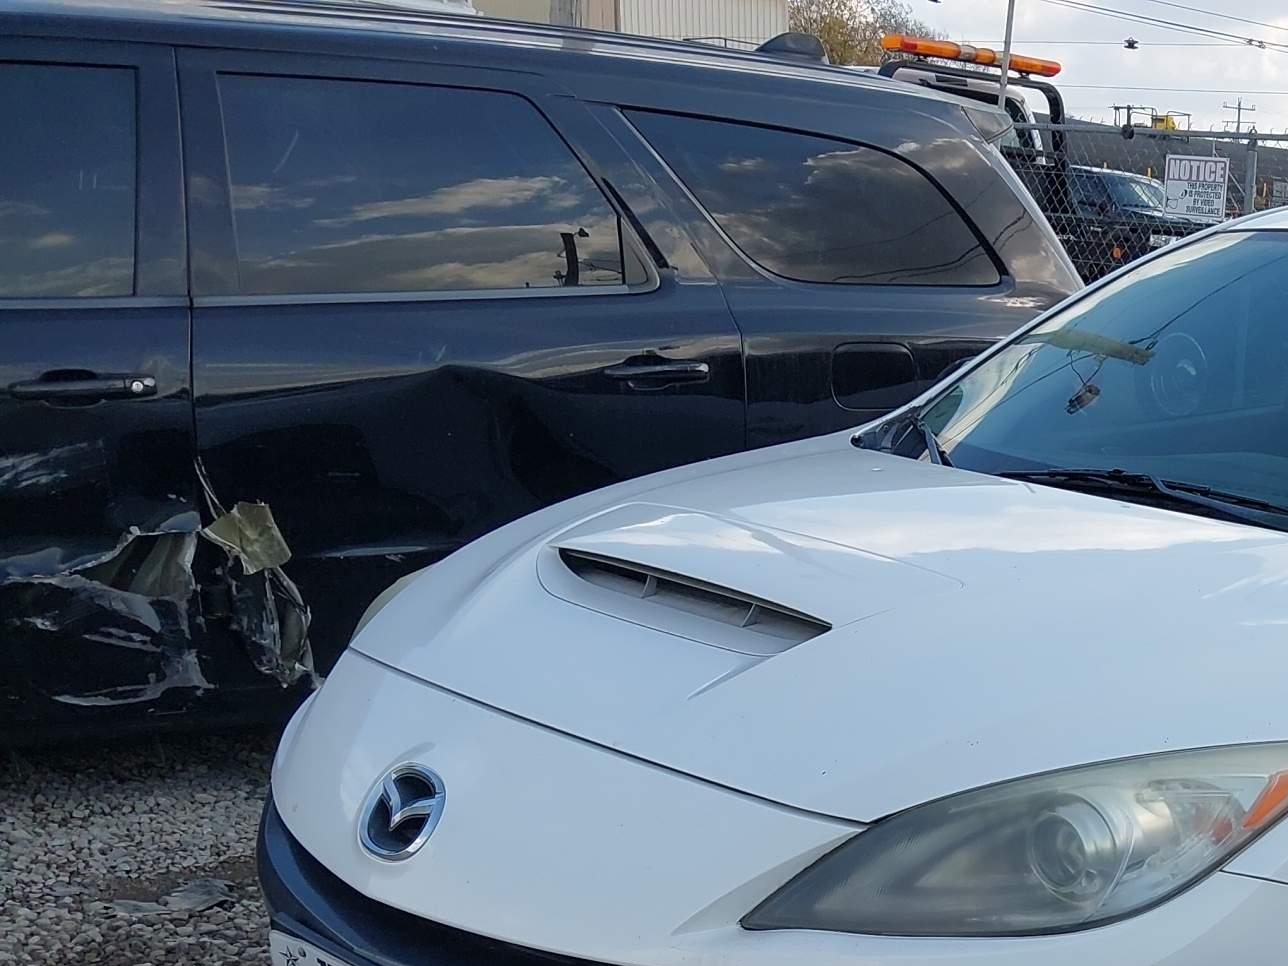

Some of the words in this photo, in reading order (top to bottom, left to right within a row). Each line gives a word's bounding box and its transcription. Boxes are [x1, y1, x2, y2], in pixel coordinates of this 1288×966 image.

[1169, 159, 1225, 182] NOTICE
[1188, 182, 1198, 190] THIS
[1198, 183, 1223, 192] PROPERTY
[1193, 191, 1221, 199] PROTECTED
[1186, 206, 1221, 215] SURVEILLANCE
